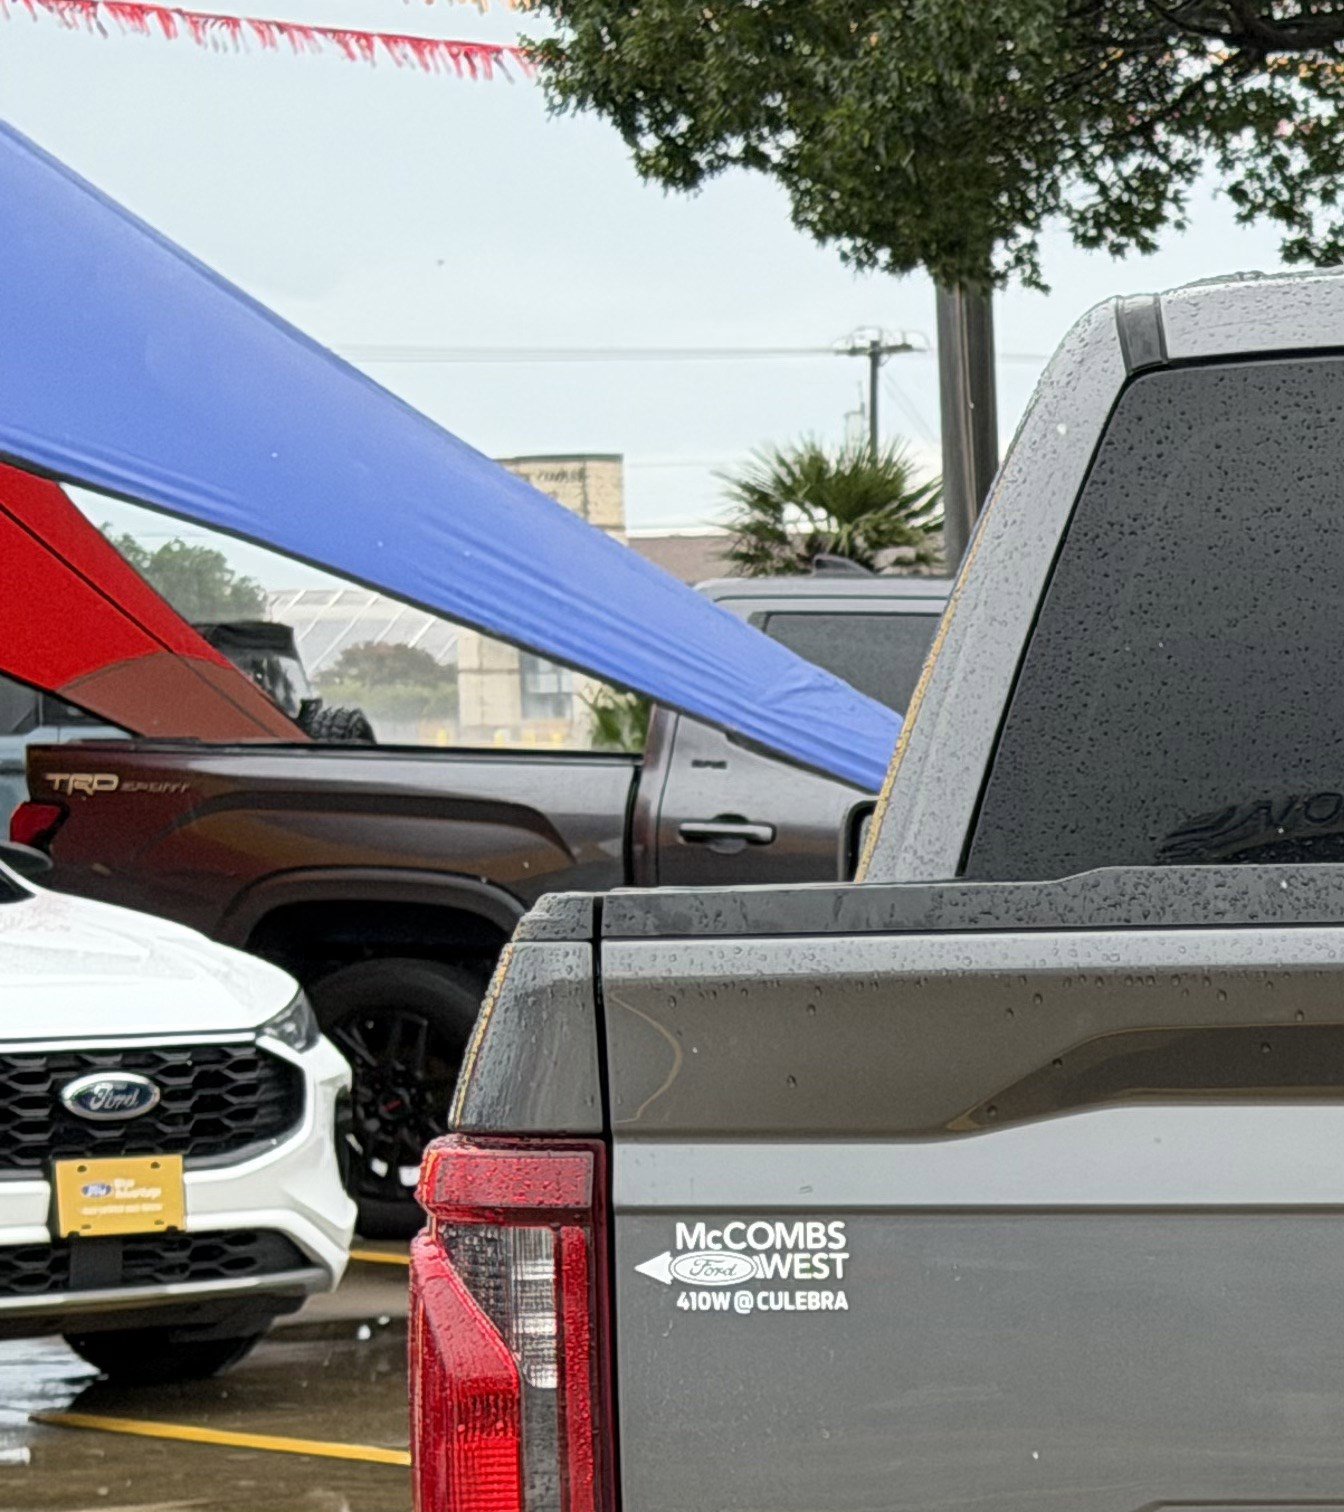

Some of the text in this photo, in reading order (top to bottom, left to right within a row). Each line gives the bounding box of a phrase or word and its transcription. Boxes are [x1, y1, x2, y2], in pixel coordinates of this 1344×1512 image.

[45, 772, 120, 796] TRD
[89, 1082, 141, 1111] Ford
[675, 1221, 847, 1250] McCOMBS
[689, 1252, 850, 1280] Ford WEST
[676, 1291, 732, 1311] 410W
[757, 1290, 849, 1311] CULEBRA
